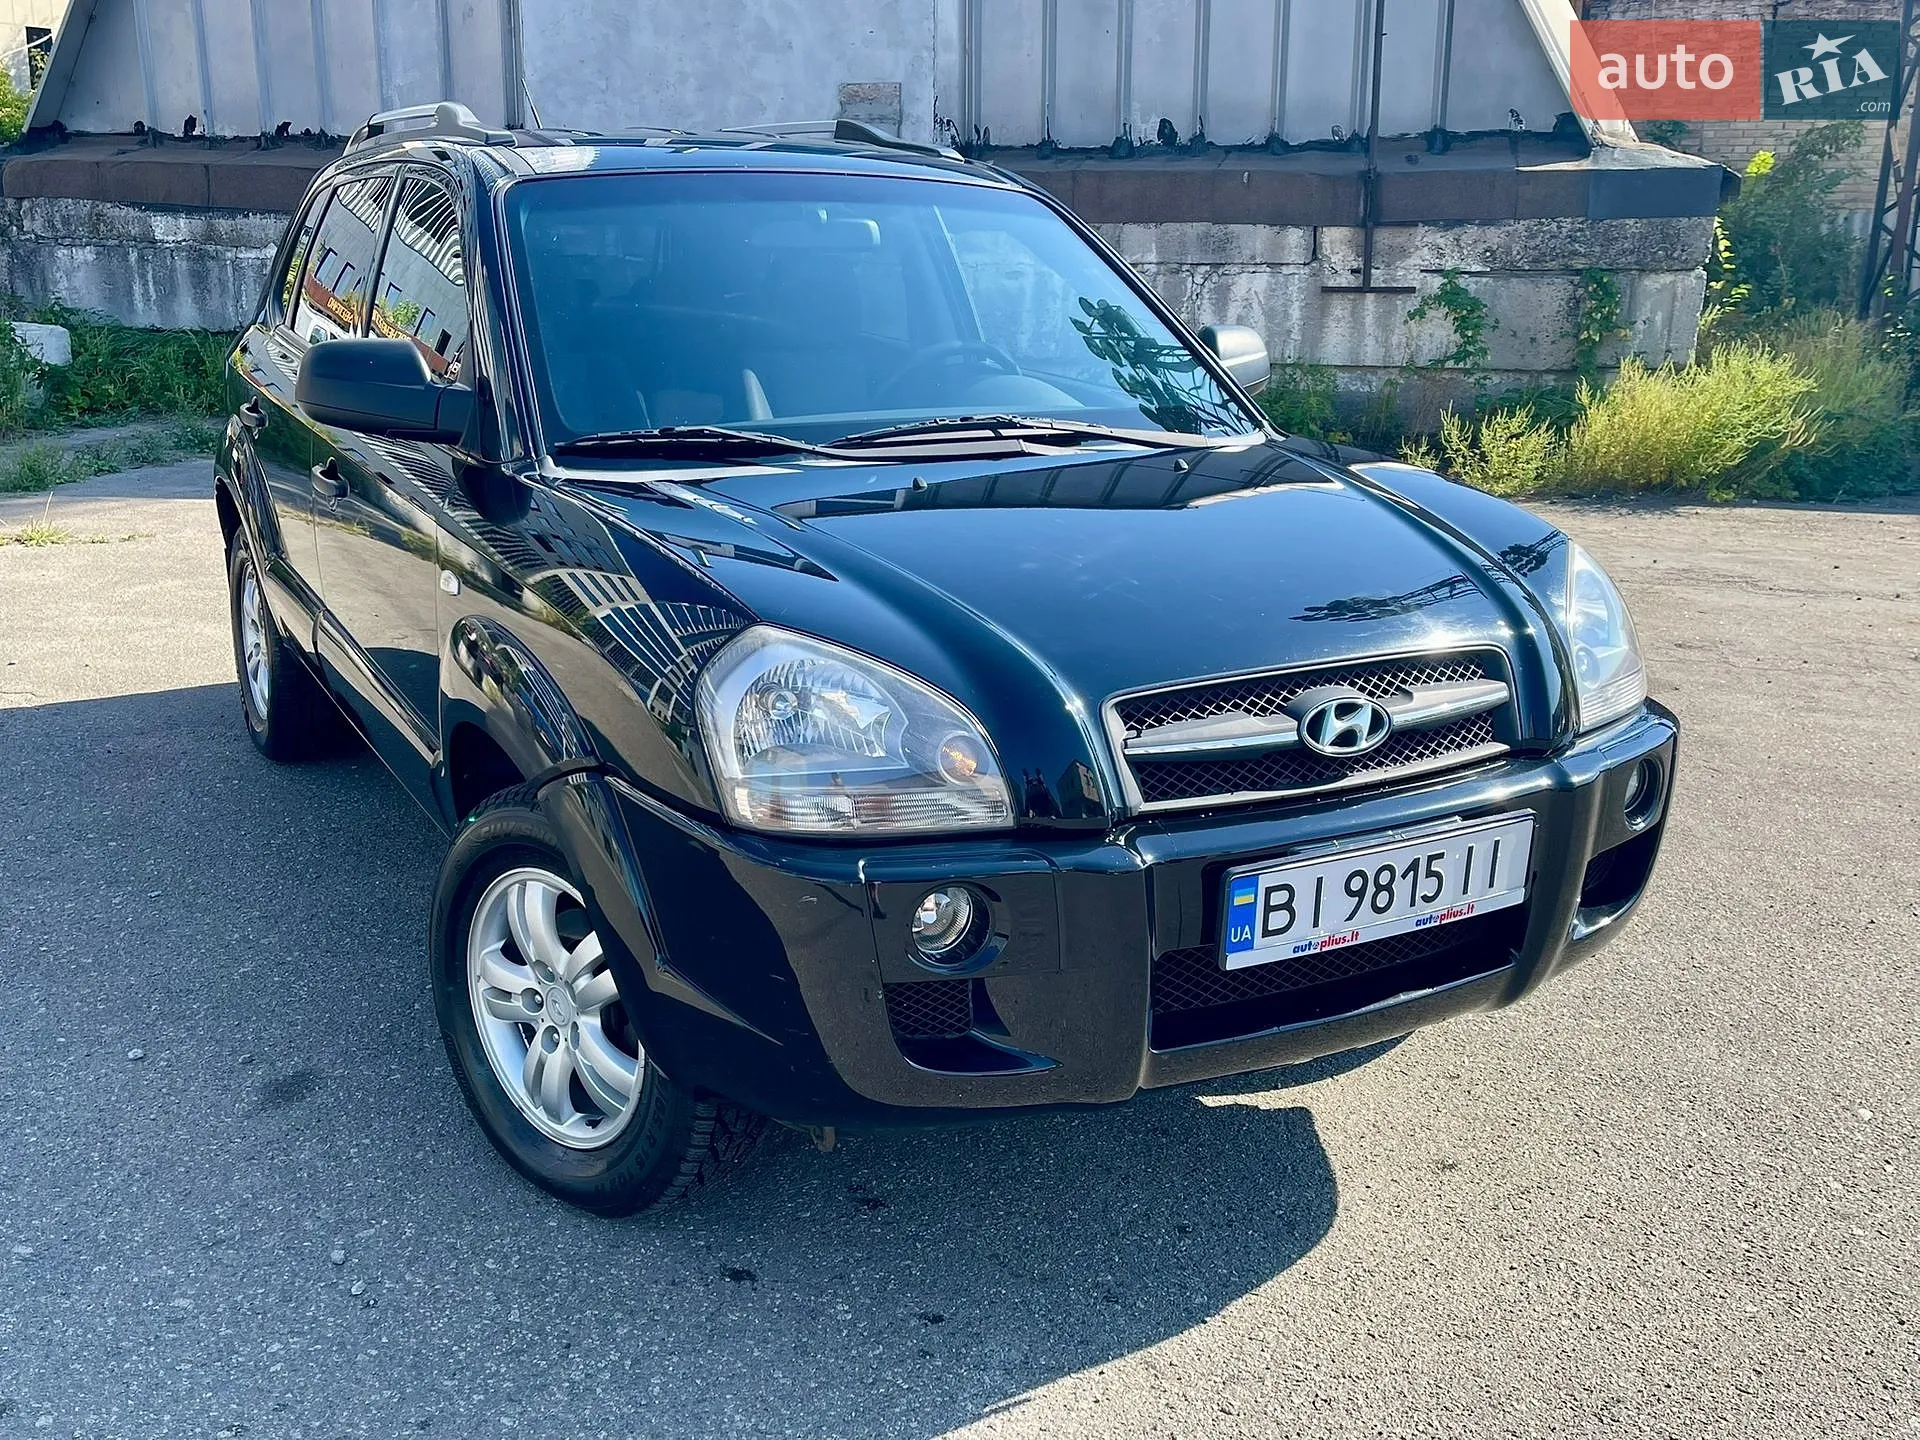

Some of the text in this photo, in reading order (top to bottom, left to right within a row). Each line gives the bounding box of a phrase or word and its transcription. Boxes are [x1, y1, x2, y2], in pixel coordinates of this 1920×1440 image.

[1261, 876, 1324, 938] BI
[1344, 851, 1446, 922] 9815
[1415, 903, 1475, 928] autoplius.lt
[1230, 927, 1252, 943] UA
[1292, 930, 1360, 954] autoplius.lt
